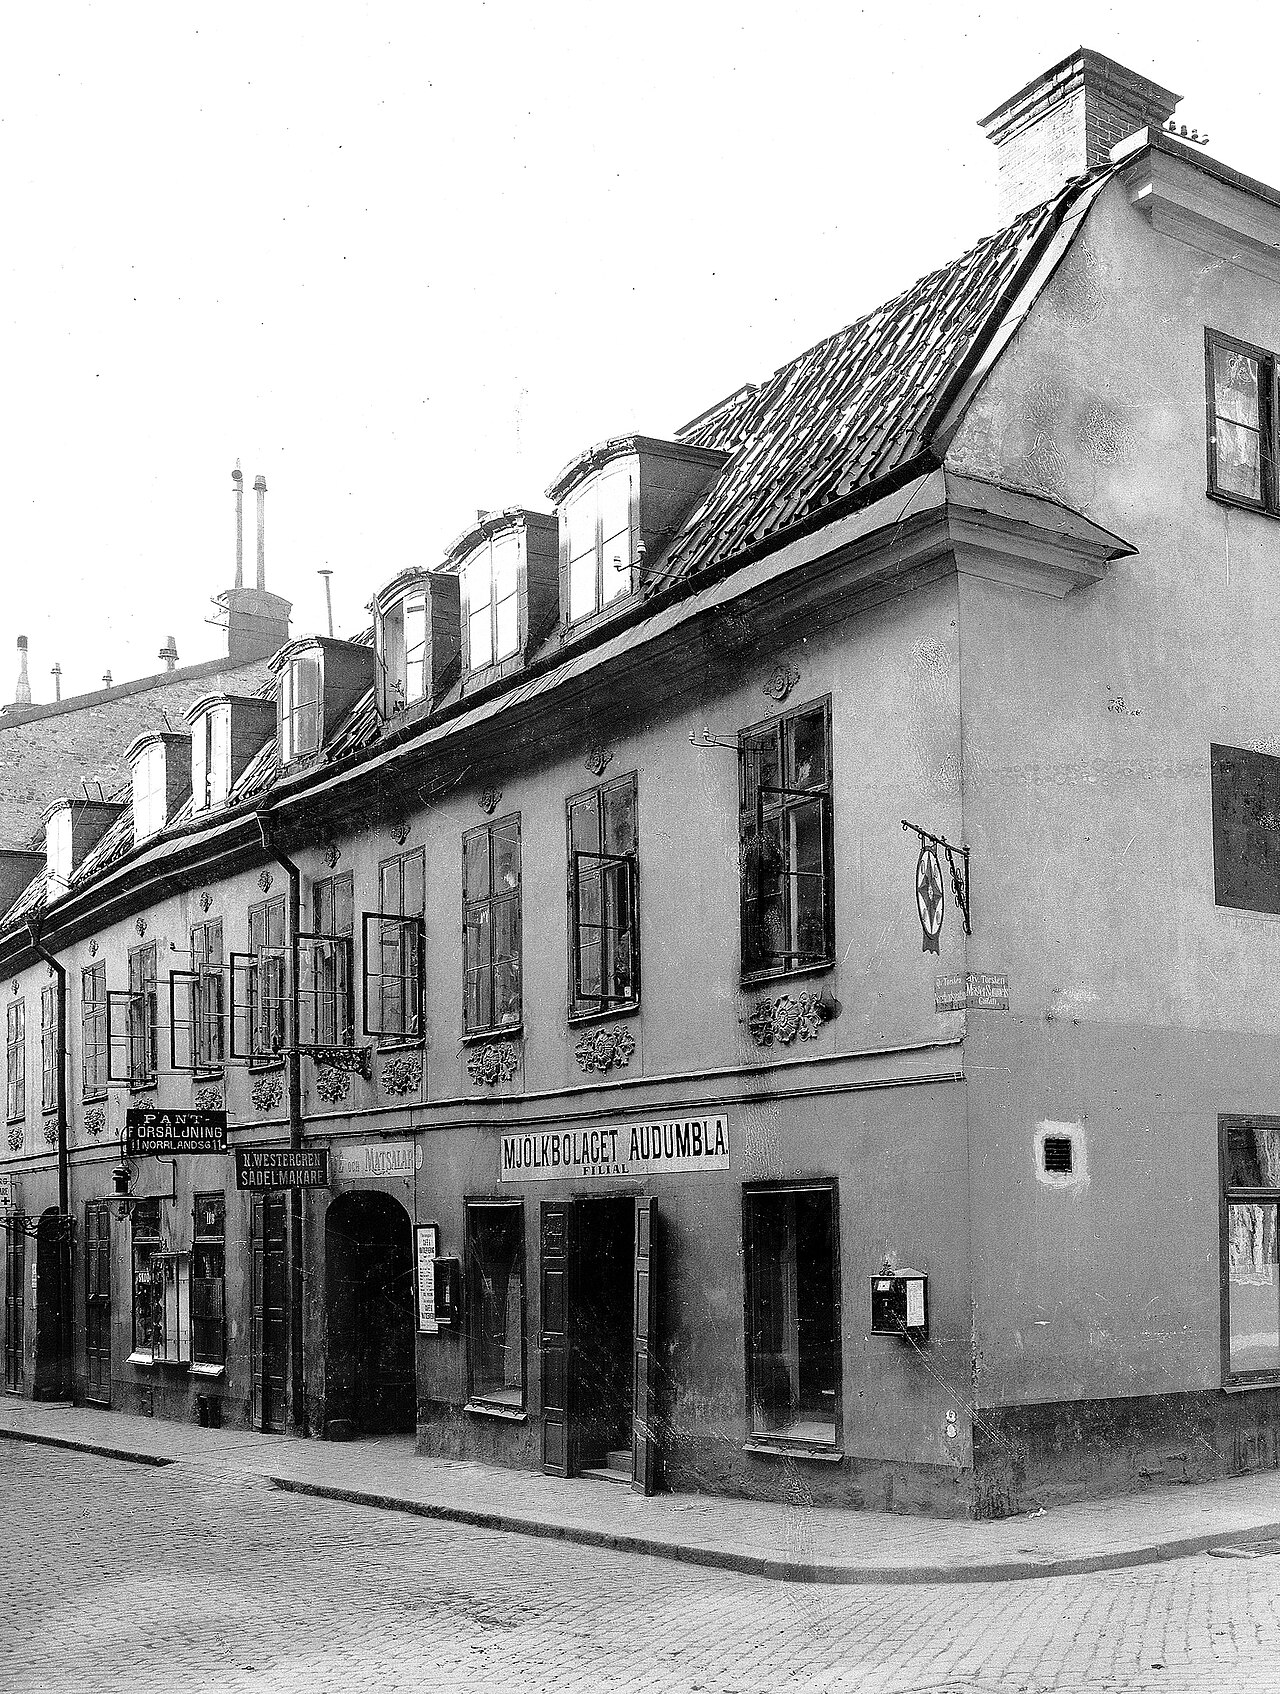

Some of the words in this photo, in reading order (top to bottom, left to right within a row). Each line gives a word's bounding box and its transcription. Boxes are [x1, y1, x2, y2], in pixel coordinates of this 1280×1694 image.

[144, 1114, 210, 1125] PANT-
[128, 1123, 223, 1138] FÖRSÄLJNING
[503, 1129, 619, 1170] MJÖLKBOLAGET
[628, 1119, 729, 1162] AUDUMBLA.
[241, 1169, 324, 1186] SADELMAKARE
[582, 1164, 630, 1176] FILIAL
